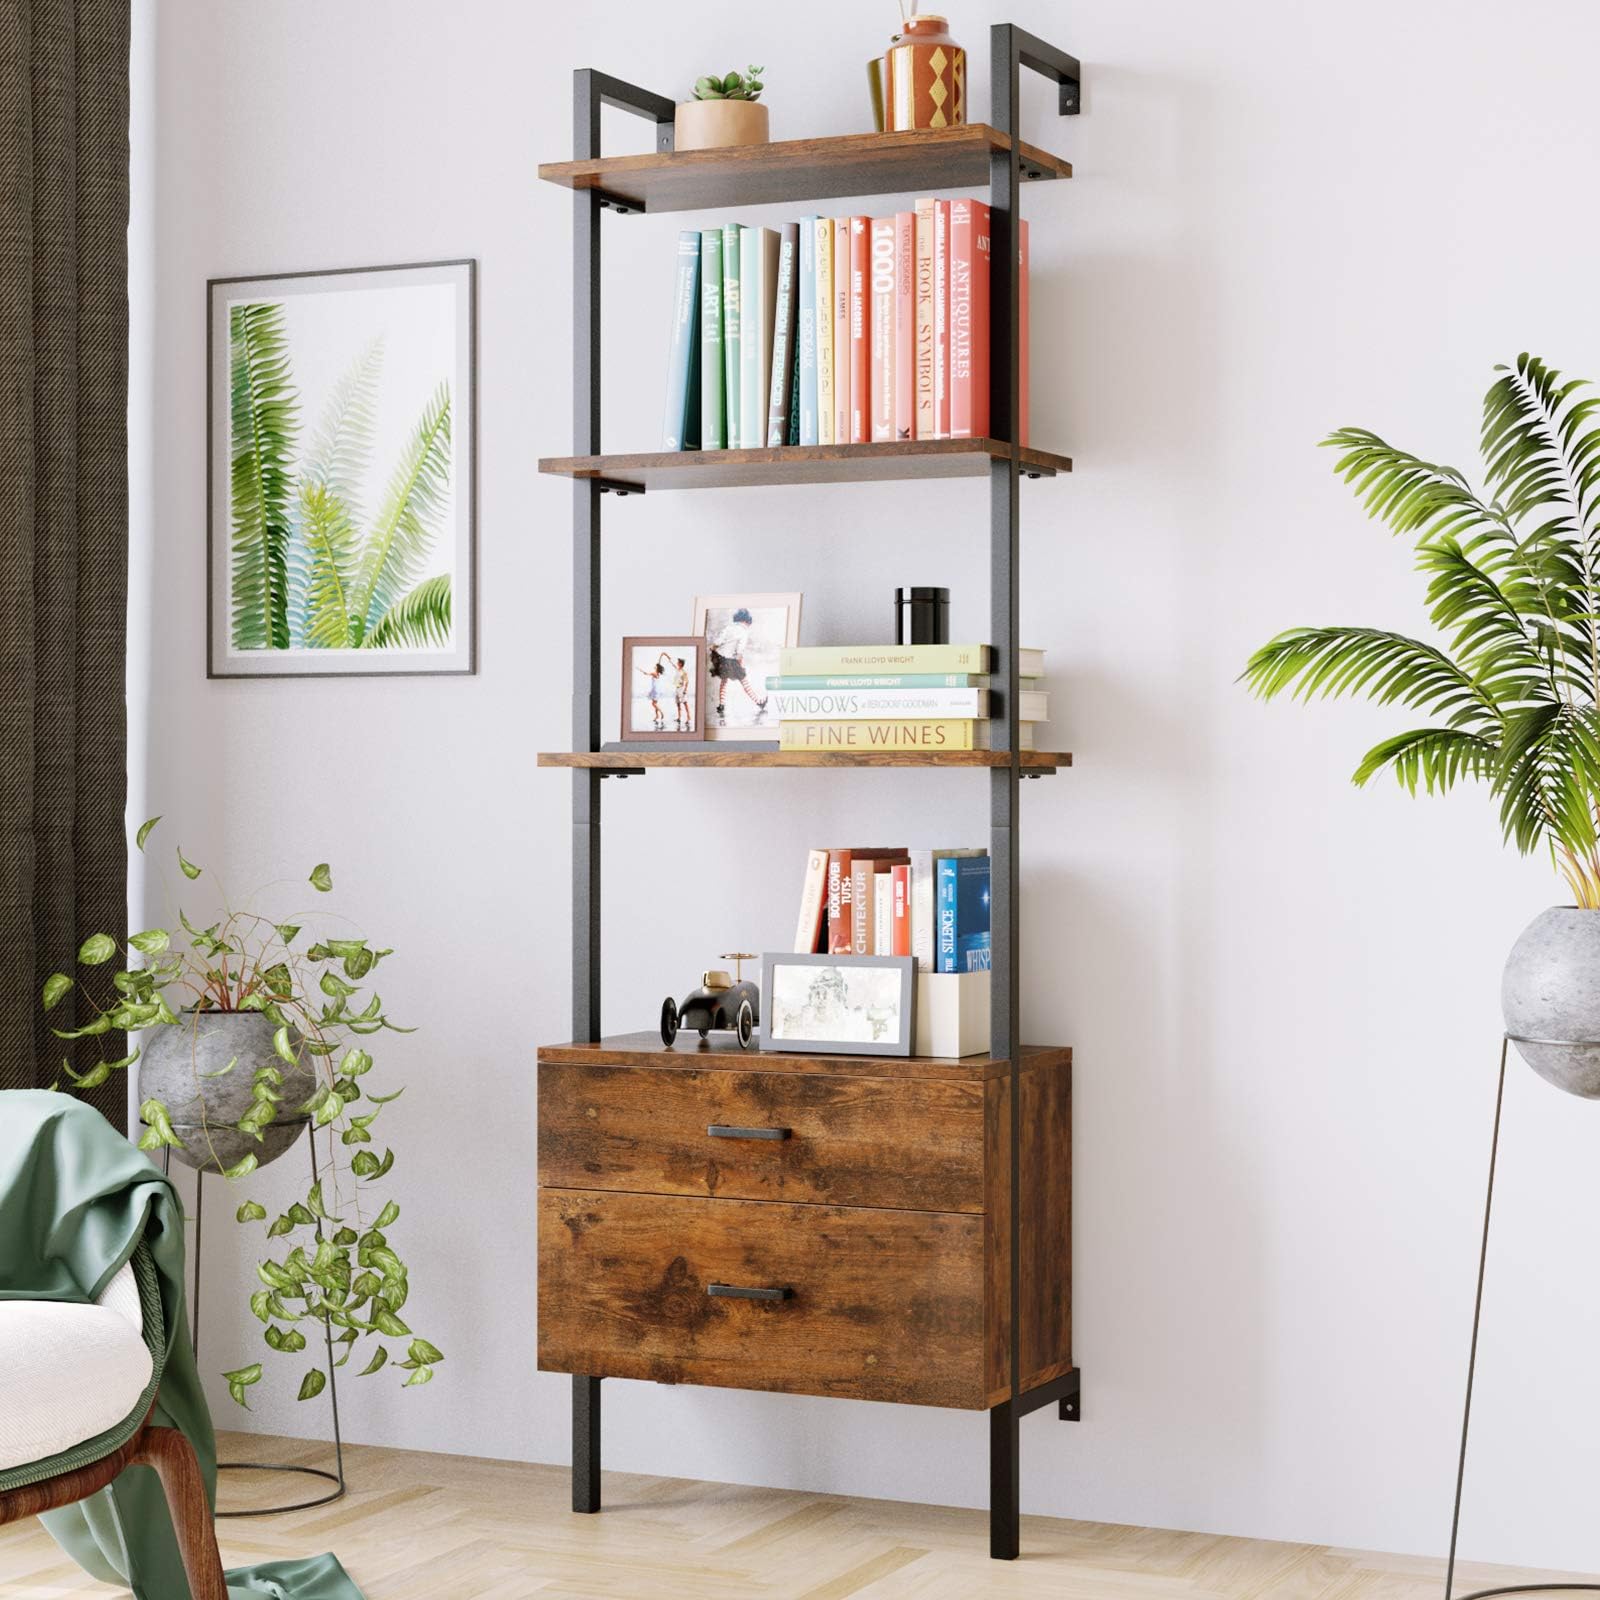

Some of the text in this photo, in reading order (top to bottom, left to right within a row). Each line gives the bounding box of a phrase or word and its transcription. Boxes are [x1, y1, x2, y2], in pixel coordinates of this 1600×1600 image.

[873, 226, 895, 293] 1000
[920, 257, 932, 304] BOOK
[703, 282, 720, 318] ART
[723, 277, 740, 313] ART
[772, 241, 793, 407] GRAPHIC DESIGN REFERENCED
[956, 260, 970, 379] ANTIQUAIRES
[920, 324, 932, 410] SYMBOLS
[841, 655, 915, 664] FRANK LLOYD WRIGHT
[774, 695, 858, 714] WINDOWS
[806, 726, 857, 745] FINE
[868, 725, 946, 745] WINES
[830, 861, 841, 919] BOOK COVER
[841, 876, 852, 905] TUTS+
[856, 871, 867, 954] CHITEKTUR
[942, 910, 954, 954] SILENCE
[944, 957, 954, 972] THE
